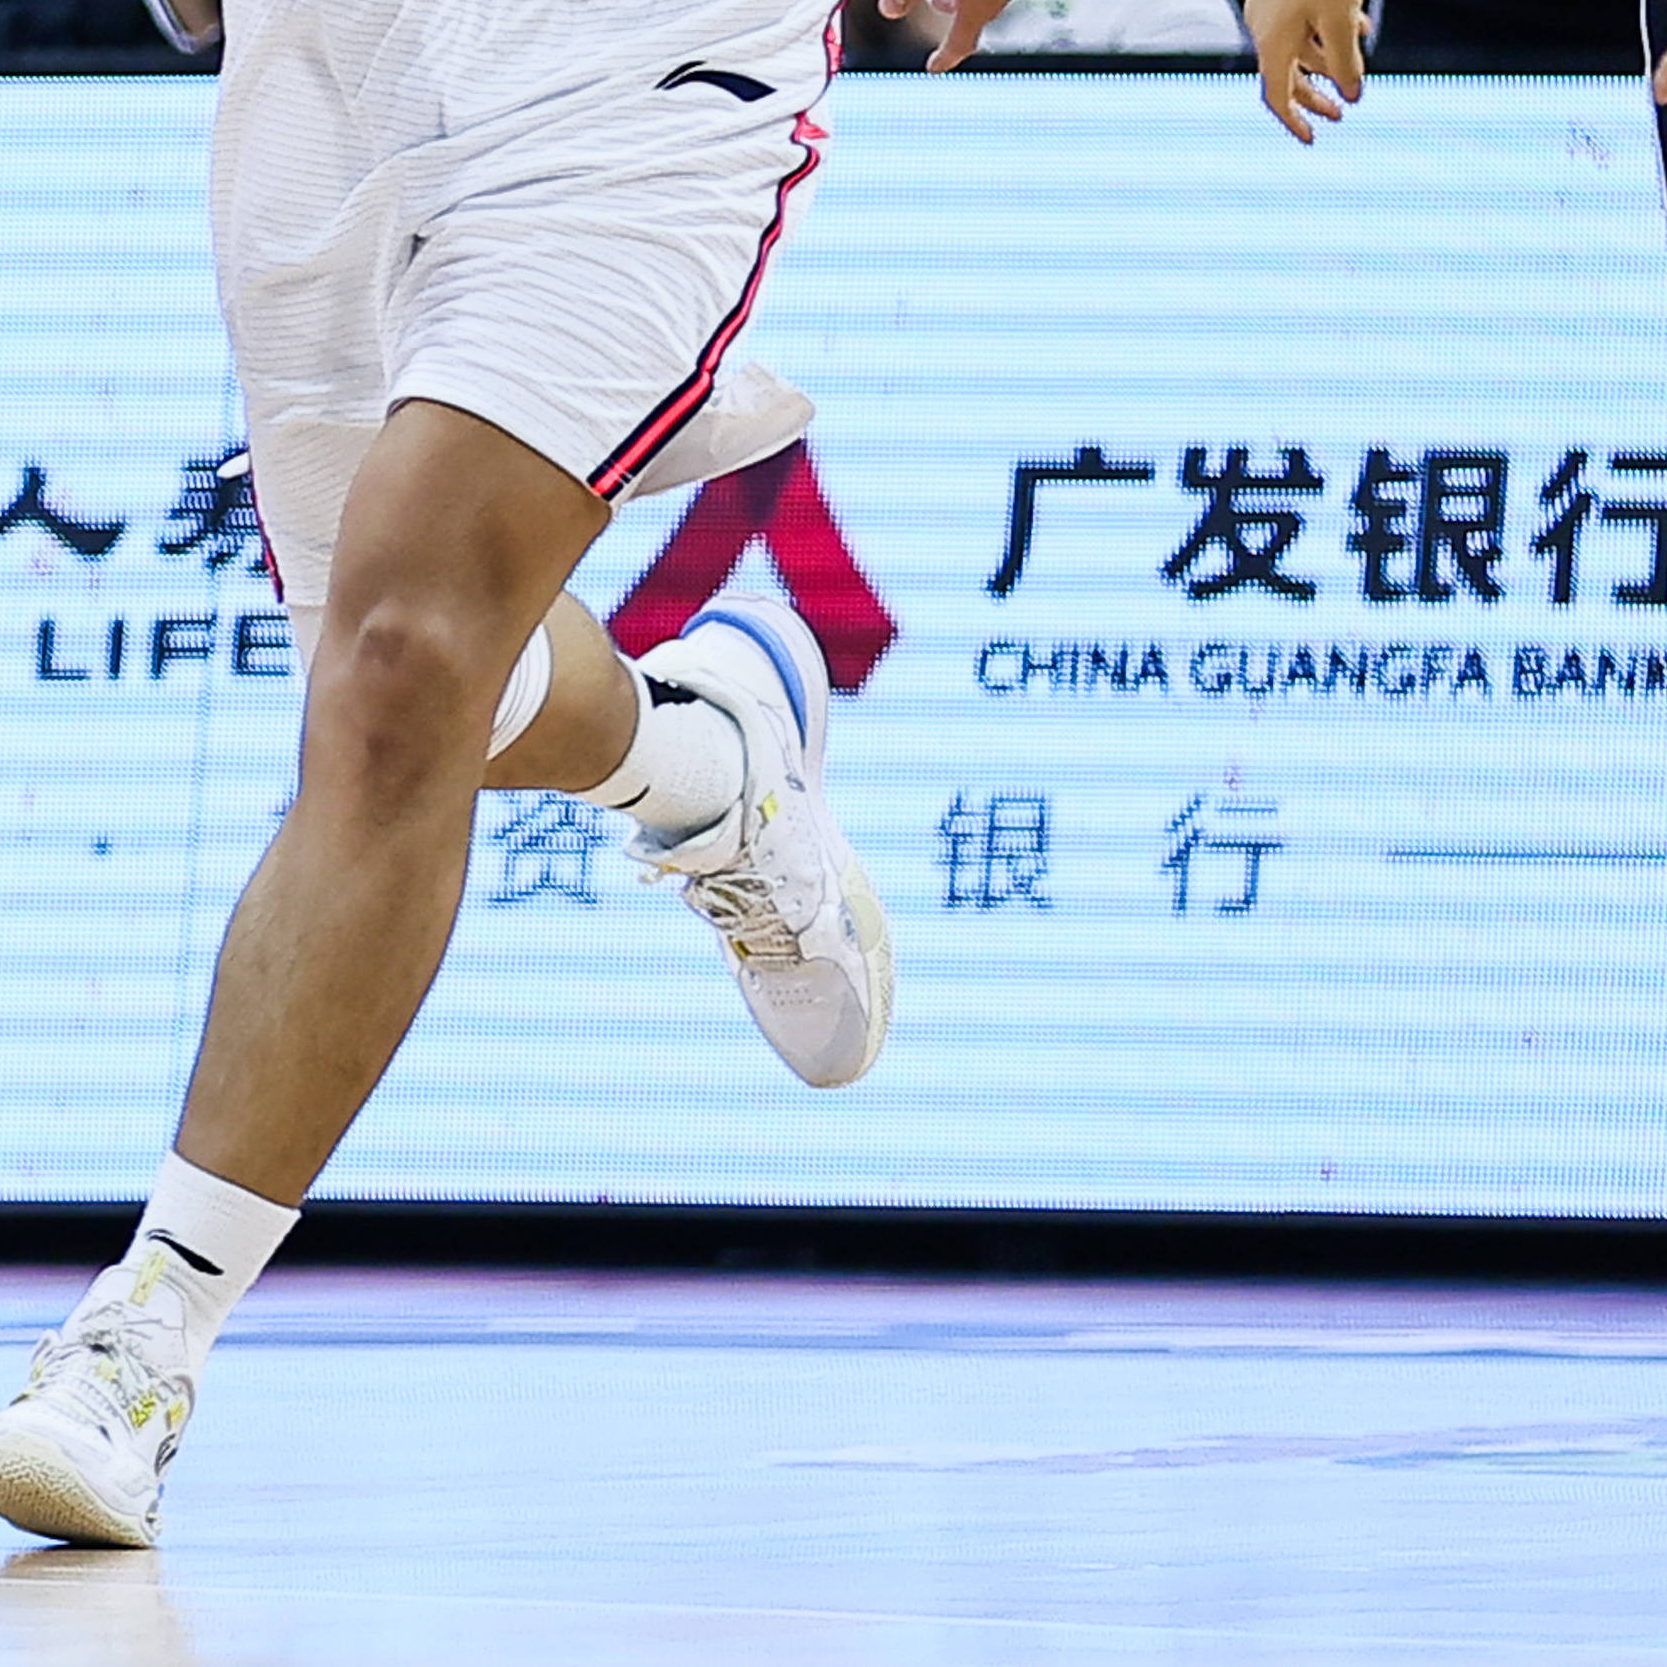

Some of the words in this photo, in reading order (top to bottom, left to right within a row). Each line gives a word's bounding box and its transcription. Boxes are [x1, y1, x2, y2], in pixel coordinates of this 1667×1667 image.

[985, 442, 1667, 607] 广发银行
[37, 611, 294, 681] LIFE
[976, 639, 1169, 696] CHINA
[1189, 640, 1489, 696] GUANGFA
[935, 789, 1285, 917] 银行
